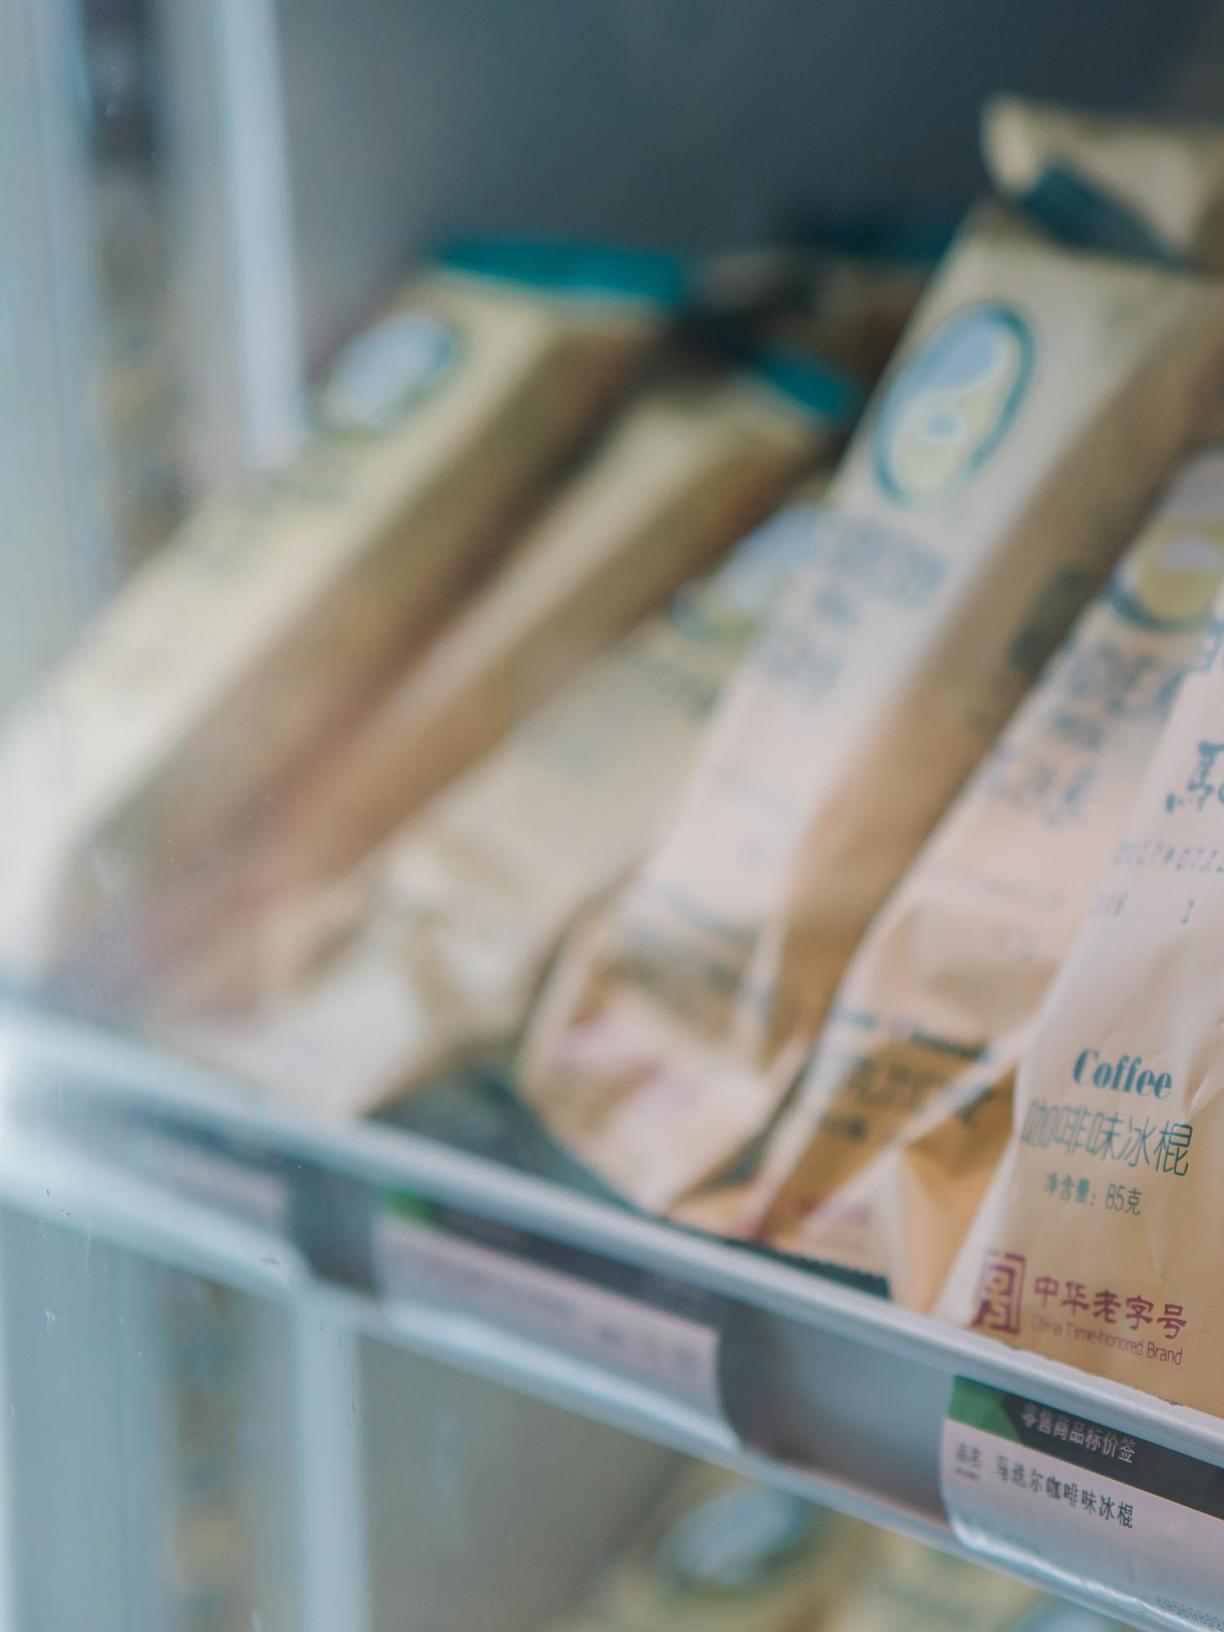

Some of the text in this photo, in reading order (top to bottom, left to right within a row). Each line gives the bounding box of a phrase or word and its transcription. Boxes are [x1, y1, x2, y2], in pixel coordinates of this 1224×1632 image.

[1072, 1048, 1172, 1100] Coffee
[1020, 1097, 1194, 1177] 咖啡味冰棍
[1033, 1274, 1189, 1340] 中华老字号
[1146, 1341, 1184, 1366] Brand
[1022, 1403, 1137, 1465] 零售商品标价签
